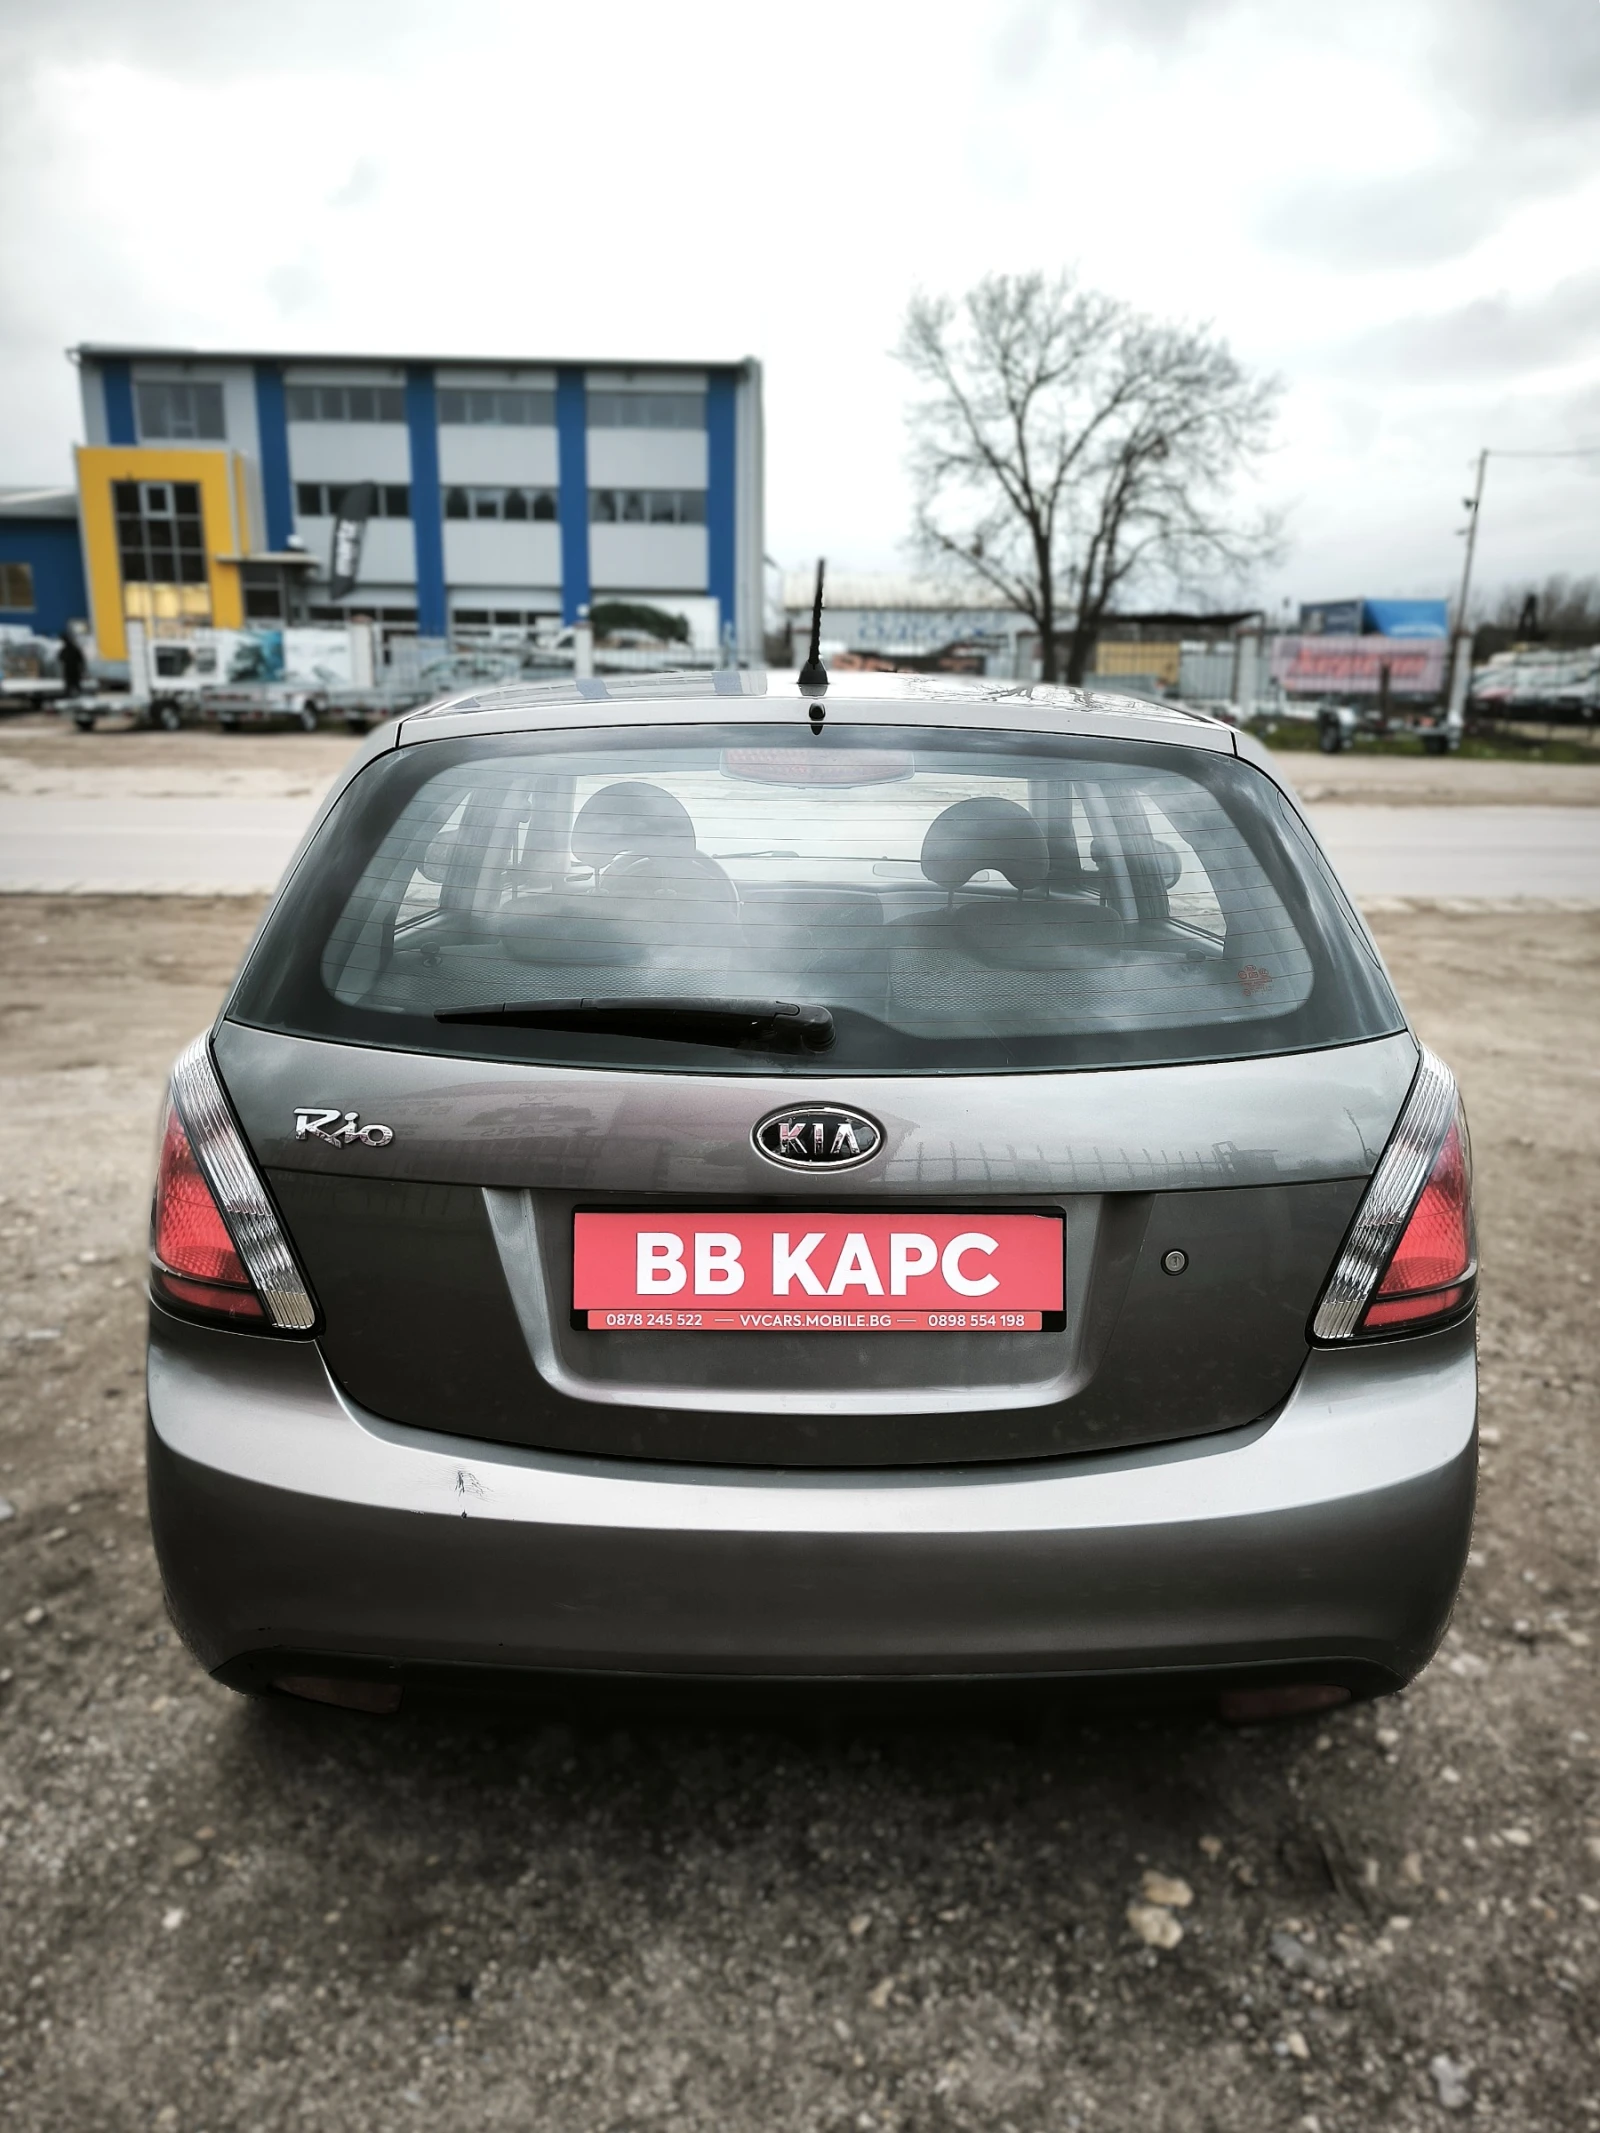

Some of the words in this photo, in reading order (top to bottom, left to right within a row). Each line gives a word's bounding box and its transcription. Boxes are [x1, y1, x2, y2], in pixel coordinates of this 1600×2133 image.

[292, 1106, 394, 1149] Rio
[778, 1122, 860, 1156] KIA
[771, 1231, 1001, 1297] КАРС
[605, 1313, 643, 1326] 0878
[646, 1313, 673, 1326] 245
[676, 1313, 703, 1326] 522
[738, 1313, 892, 1327] VVCARS.MOBILE.BG
[927, 1314, 966, 1327] 0898
[969, 1314, 997, 1327] 554
[999, 1314, 1025, 1327] 198
